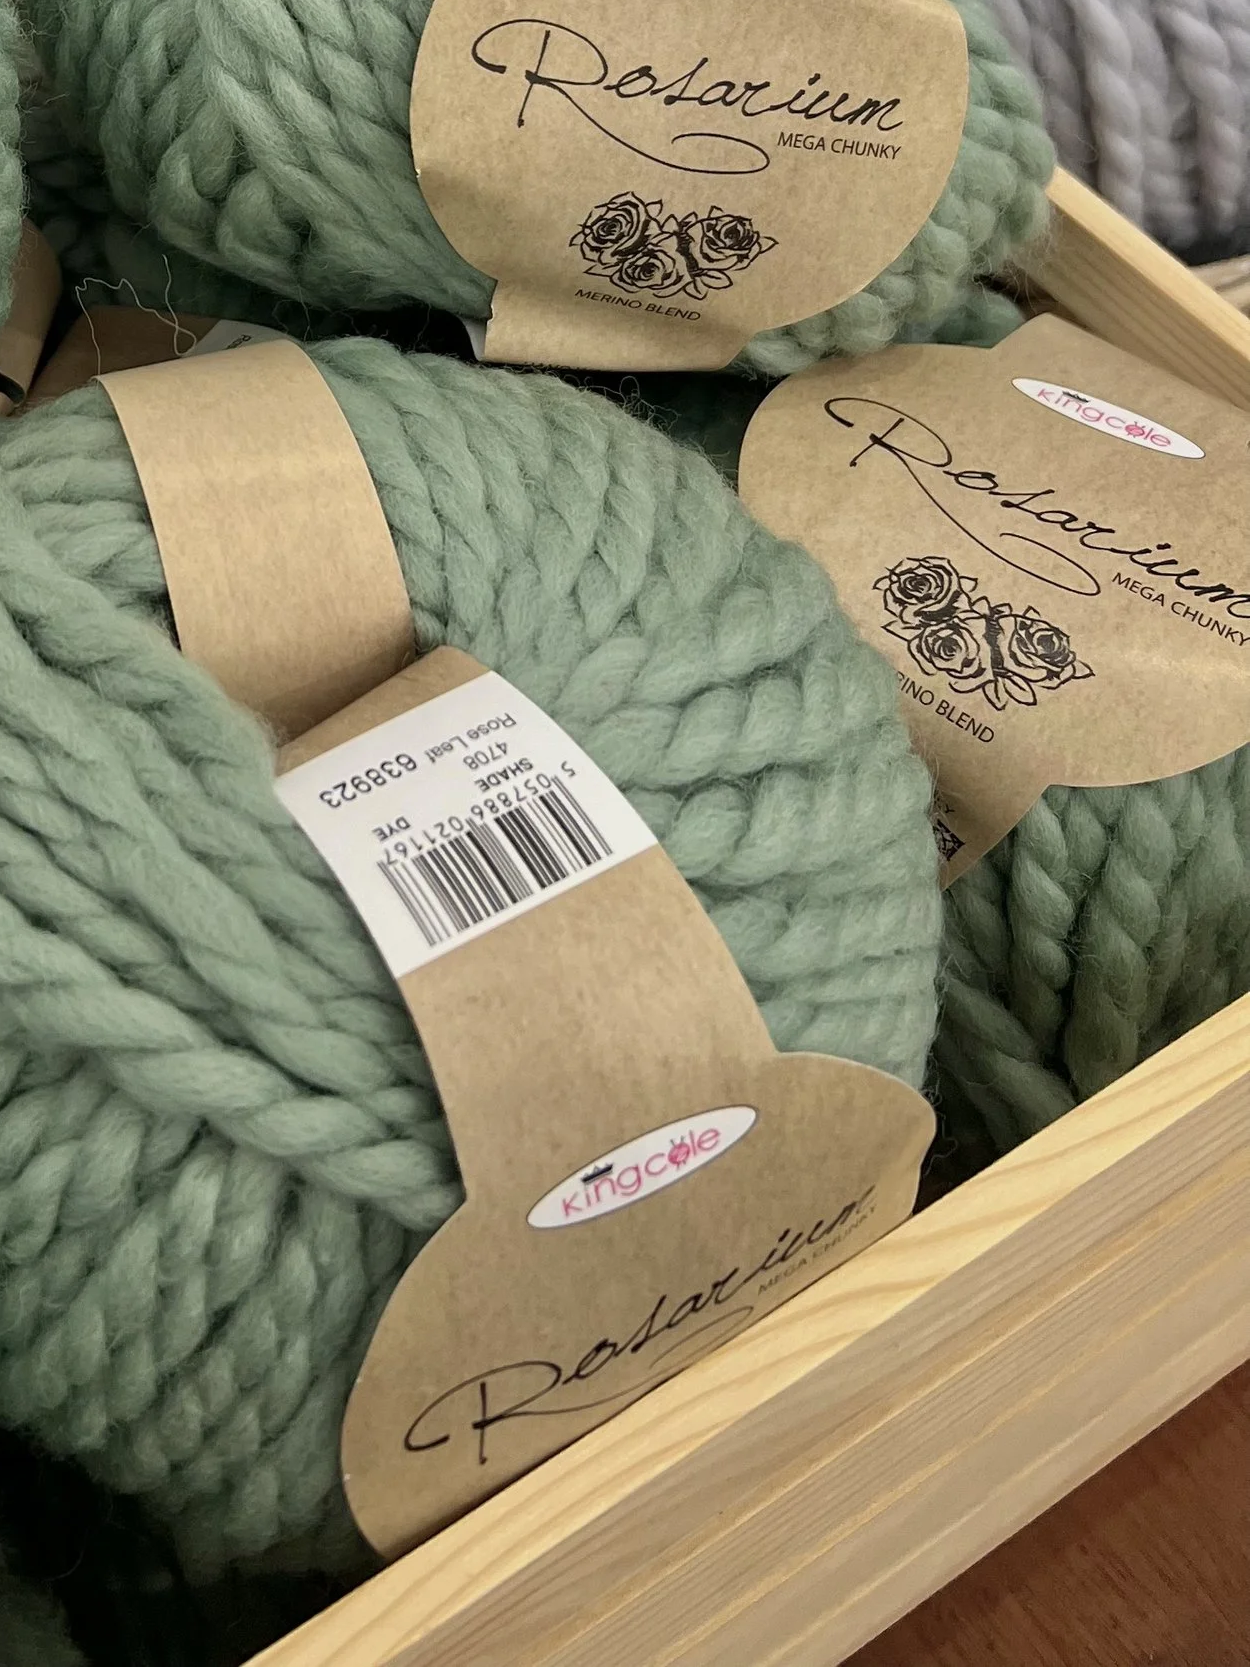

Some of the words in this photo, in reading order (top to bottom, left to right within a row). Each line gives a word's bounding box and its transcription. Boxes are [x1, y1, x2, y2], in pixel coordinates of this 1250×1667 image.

[471, 18, 904, 175] Rosarium
[777, 131, 828, 154] MEGA
[830, 137, 902, 161] CHUNKY
[574, 289, 642, 309] MERINO
[644, 303, 701, 321] BLEND
[824, 397, 1250, 618] Rosarium
[1112, 572, 1165, 607] MEGA
[1171, 601, 1250, 647] CHUNKY
[468, 712, 517, 744] Rose
[935, 699, 995, 743] BLEND
[425, 734, 468, 765] Leaf
[463, 740, 509, 771] 4708
[561, 760, 577, 778] 5
[319, 753, 418, 809] 638923
[474, 757, 534, 793] SHADE
[470, 774, 552, 821] 057886
[371, 816, 411, 843] DYE
[383, 815, 465, 865] 021167
[404, 1185, 877, 1465] Rosarium
